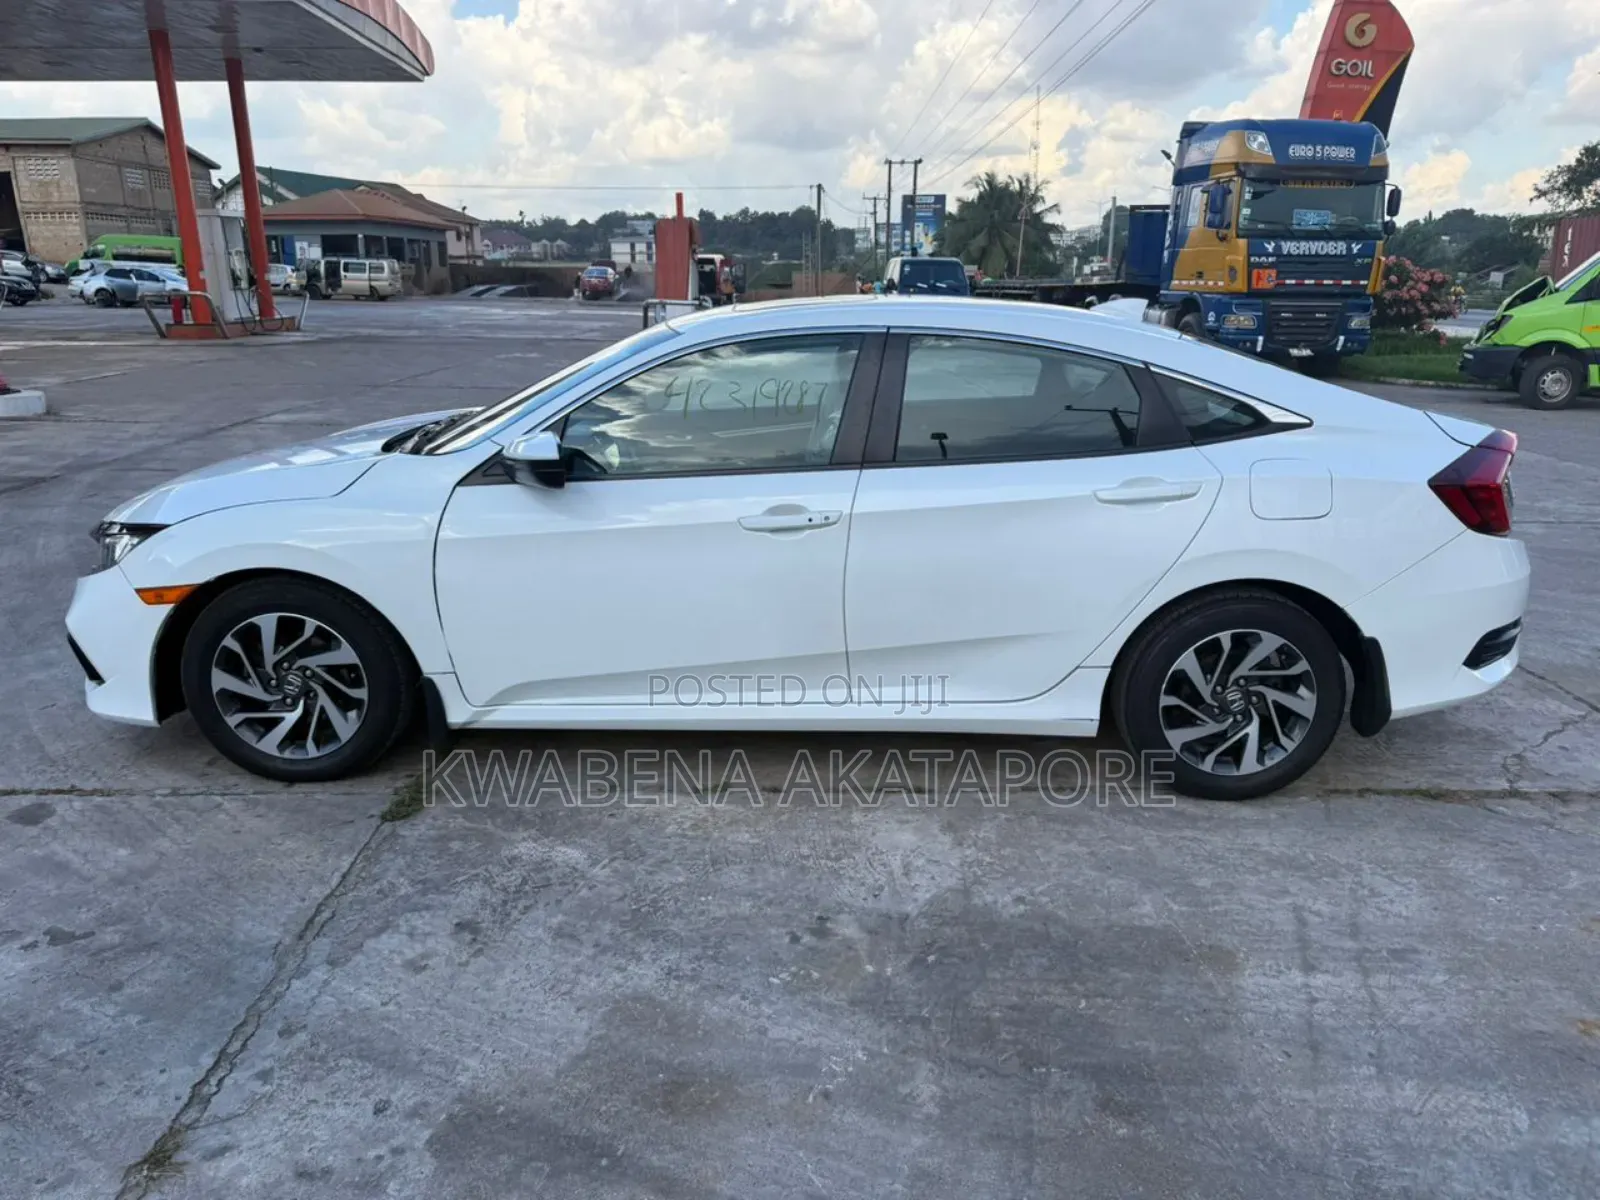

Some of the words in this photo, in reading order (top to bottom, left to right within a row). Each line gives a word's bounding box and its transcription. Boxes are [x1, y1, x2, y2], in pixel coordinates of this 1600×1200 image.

[1330, 58, 1375, 78] GOIL
[1289, 144, 1314, 159] EURO
[1315, 145, 1323, 159] 5
[1324, 146, 1356, 161] POWER
[1280, 240, 1348, 255] VERVOER
[1250, 256, 1277, 264] DAF
